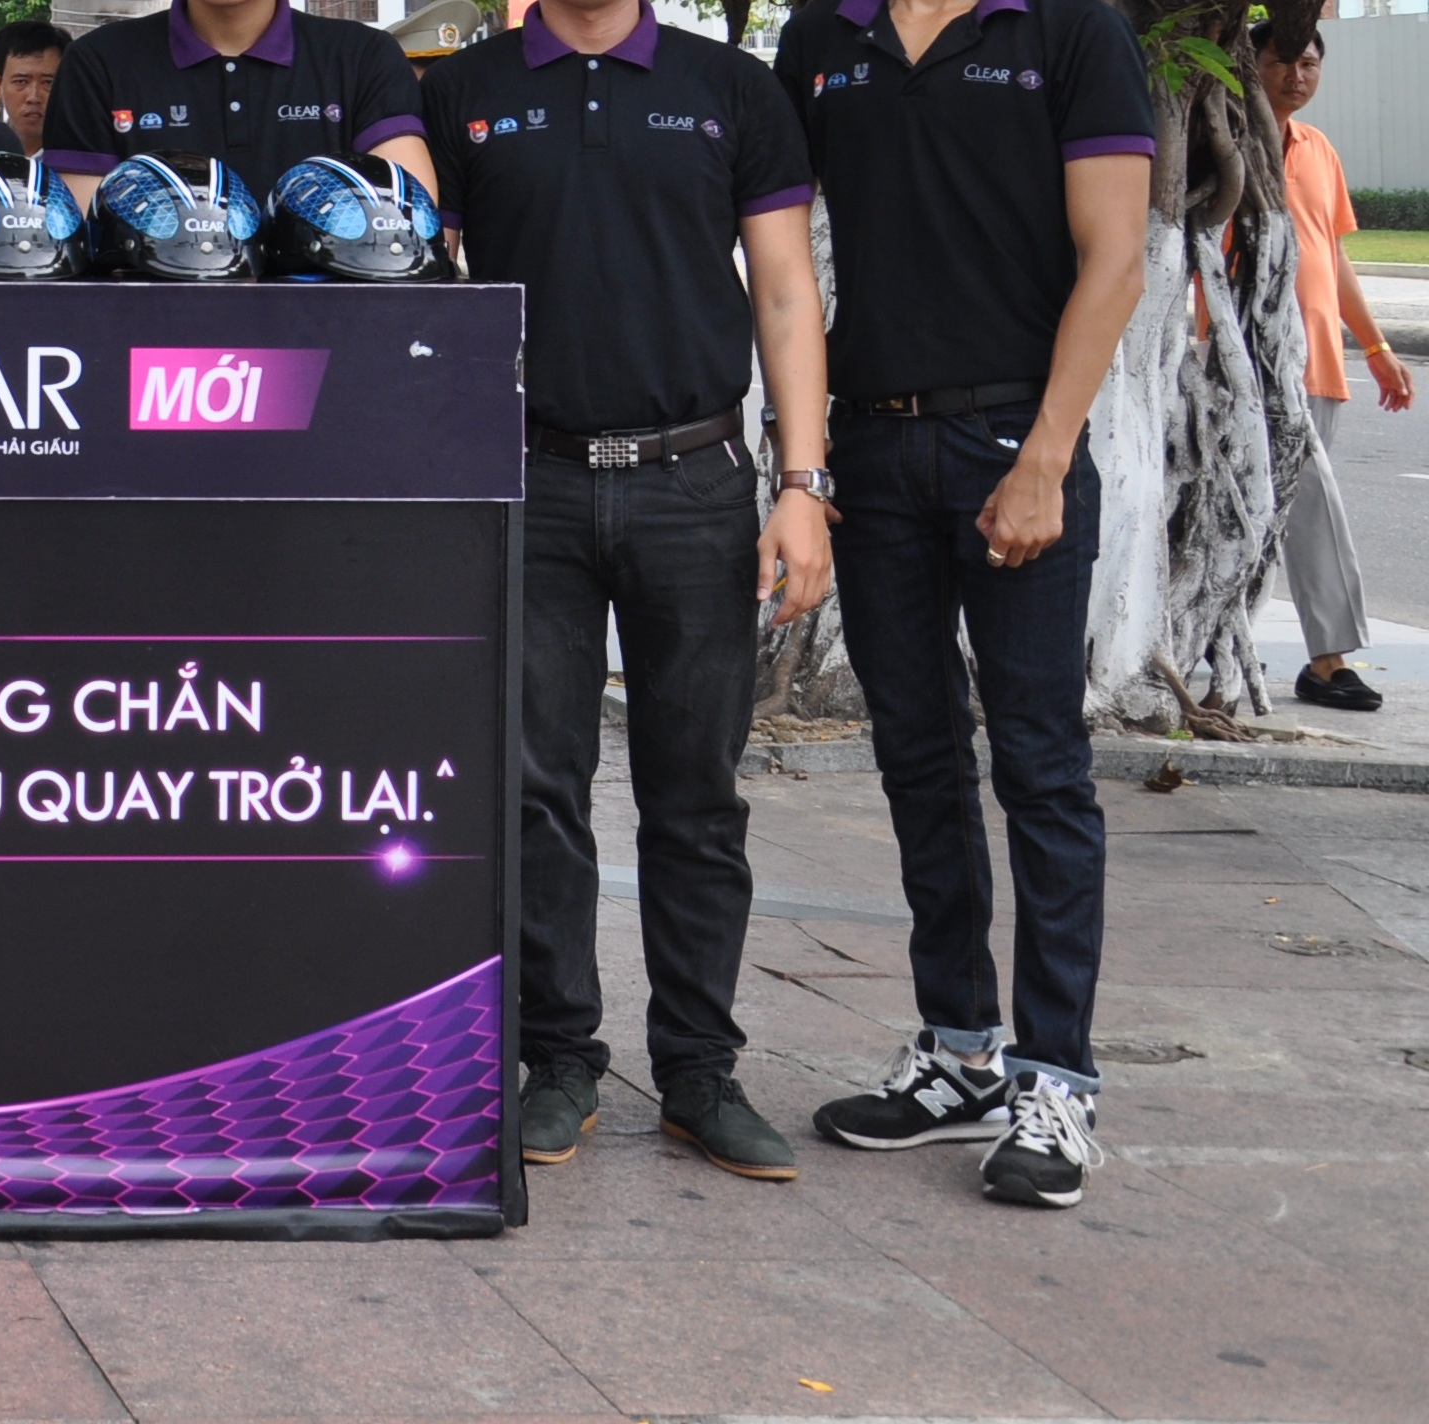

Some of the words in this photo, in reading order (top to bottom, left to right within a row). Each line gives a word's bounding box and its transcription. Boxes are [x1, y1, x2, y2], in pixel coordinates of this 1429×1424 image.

[963, 63, 1011, 81] CLEAR
[277, 104, 321, 119] CLEAR
[647, 112, 695, 129] CLEAR
[2, 214, 42, 230] CLEAR
[184, 217, 225, 233] CLEAR
[372, 215, 411, 231] CLEAR
[138, 353, 262, 423] MỚI
[29, 436, 80, 456] GIẤU!
[73, 661, 261, 733] CHẮN
[17, 769, 196, 823] QUAY
[208, 755, 324, 822] TRỞ
